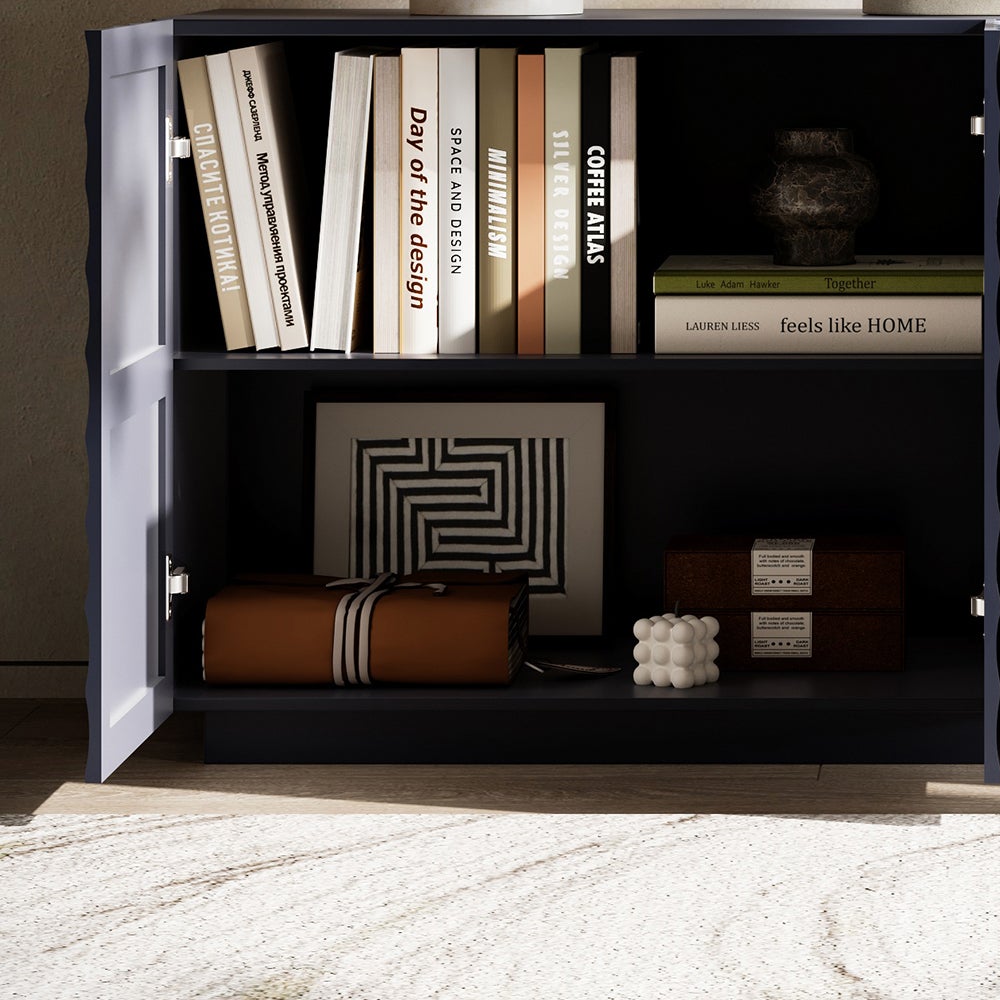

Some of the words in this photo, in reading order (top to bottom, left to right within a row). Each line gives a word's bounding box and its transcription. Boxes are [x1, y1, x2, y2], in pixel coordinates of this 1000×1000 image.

[242, 70, 255, 99] ДЖЕФФ
[248, 99, 263, 142] САЗЕРЛЕНД
[406, 107, 428, 151] Day
[193, 122, 226, 207] СПАСИТЕ
[256, 152, 271, 191] Метод
[410, 158, 428, 184] of
[450, 128, 462, 174] SPACE
[552, 130, 569, 197] SILVER
[450, 181, 462, 212] AND
[586, 145, 605, 207] COFFEE
[260, 189, 284, 263] управления
[410, 188, 428, 226] the
[488, 147, 507, 259] MINIMALISM
[208, 210, 241, 292] КОТИКА!
[450, 219, 462, 274] DESIGN
[552, 208, 569, 280] DESIGN
[586, 212, 605, 265] ATLAS
[406, 232, 428, 309] design
[696, 280, 716, 289] Luke
[720, 280, 744, 289] Adam
[750, 280, 780, 289] Hawker
[824, 277, 876, 292] Together
[274, 265, 295, 327] проектами
[686, 321, 729, 331] LAUREN
[732, 321, 760, 331] LIESS
[780, 318, 823, 333] feels
[828, 317, 862, 333] like
[867, 318, 927, 333] HOME
